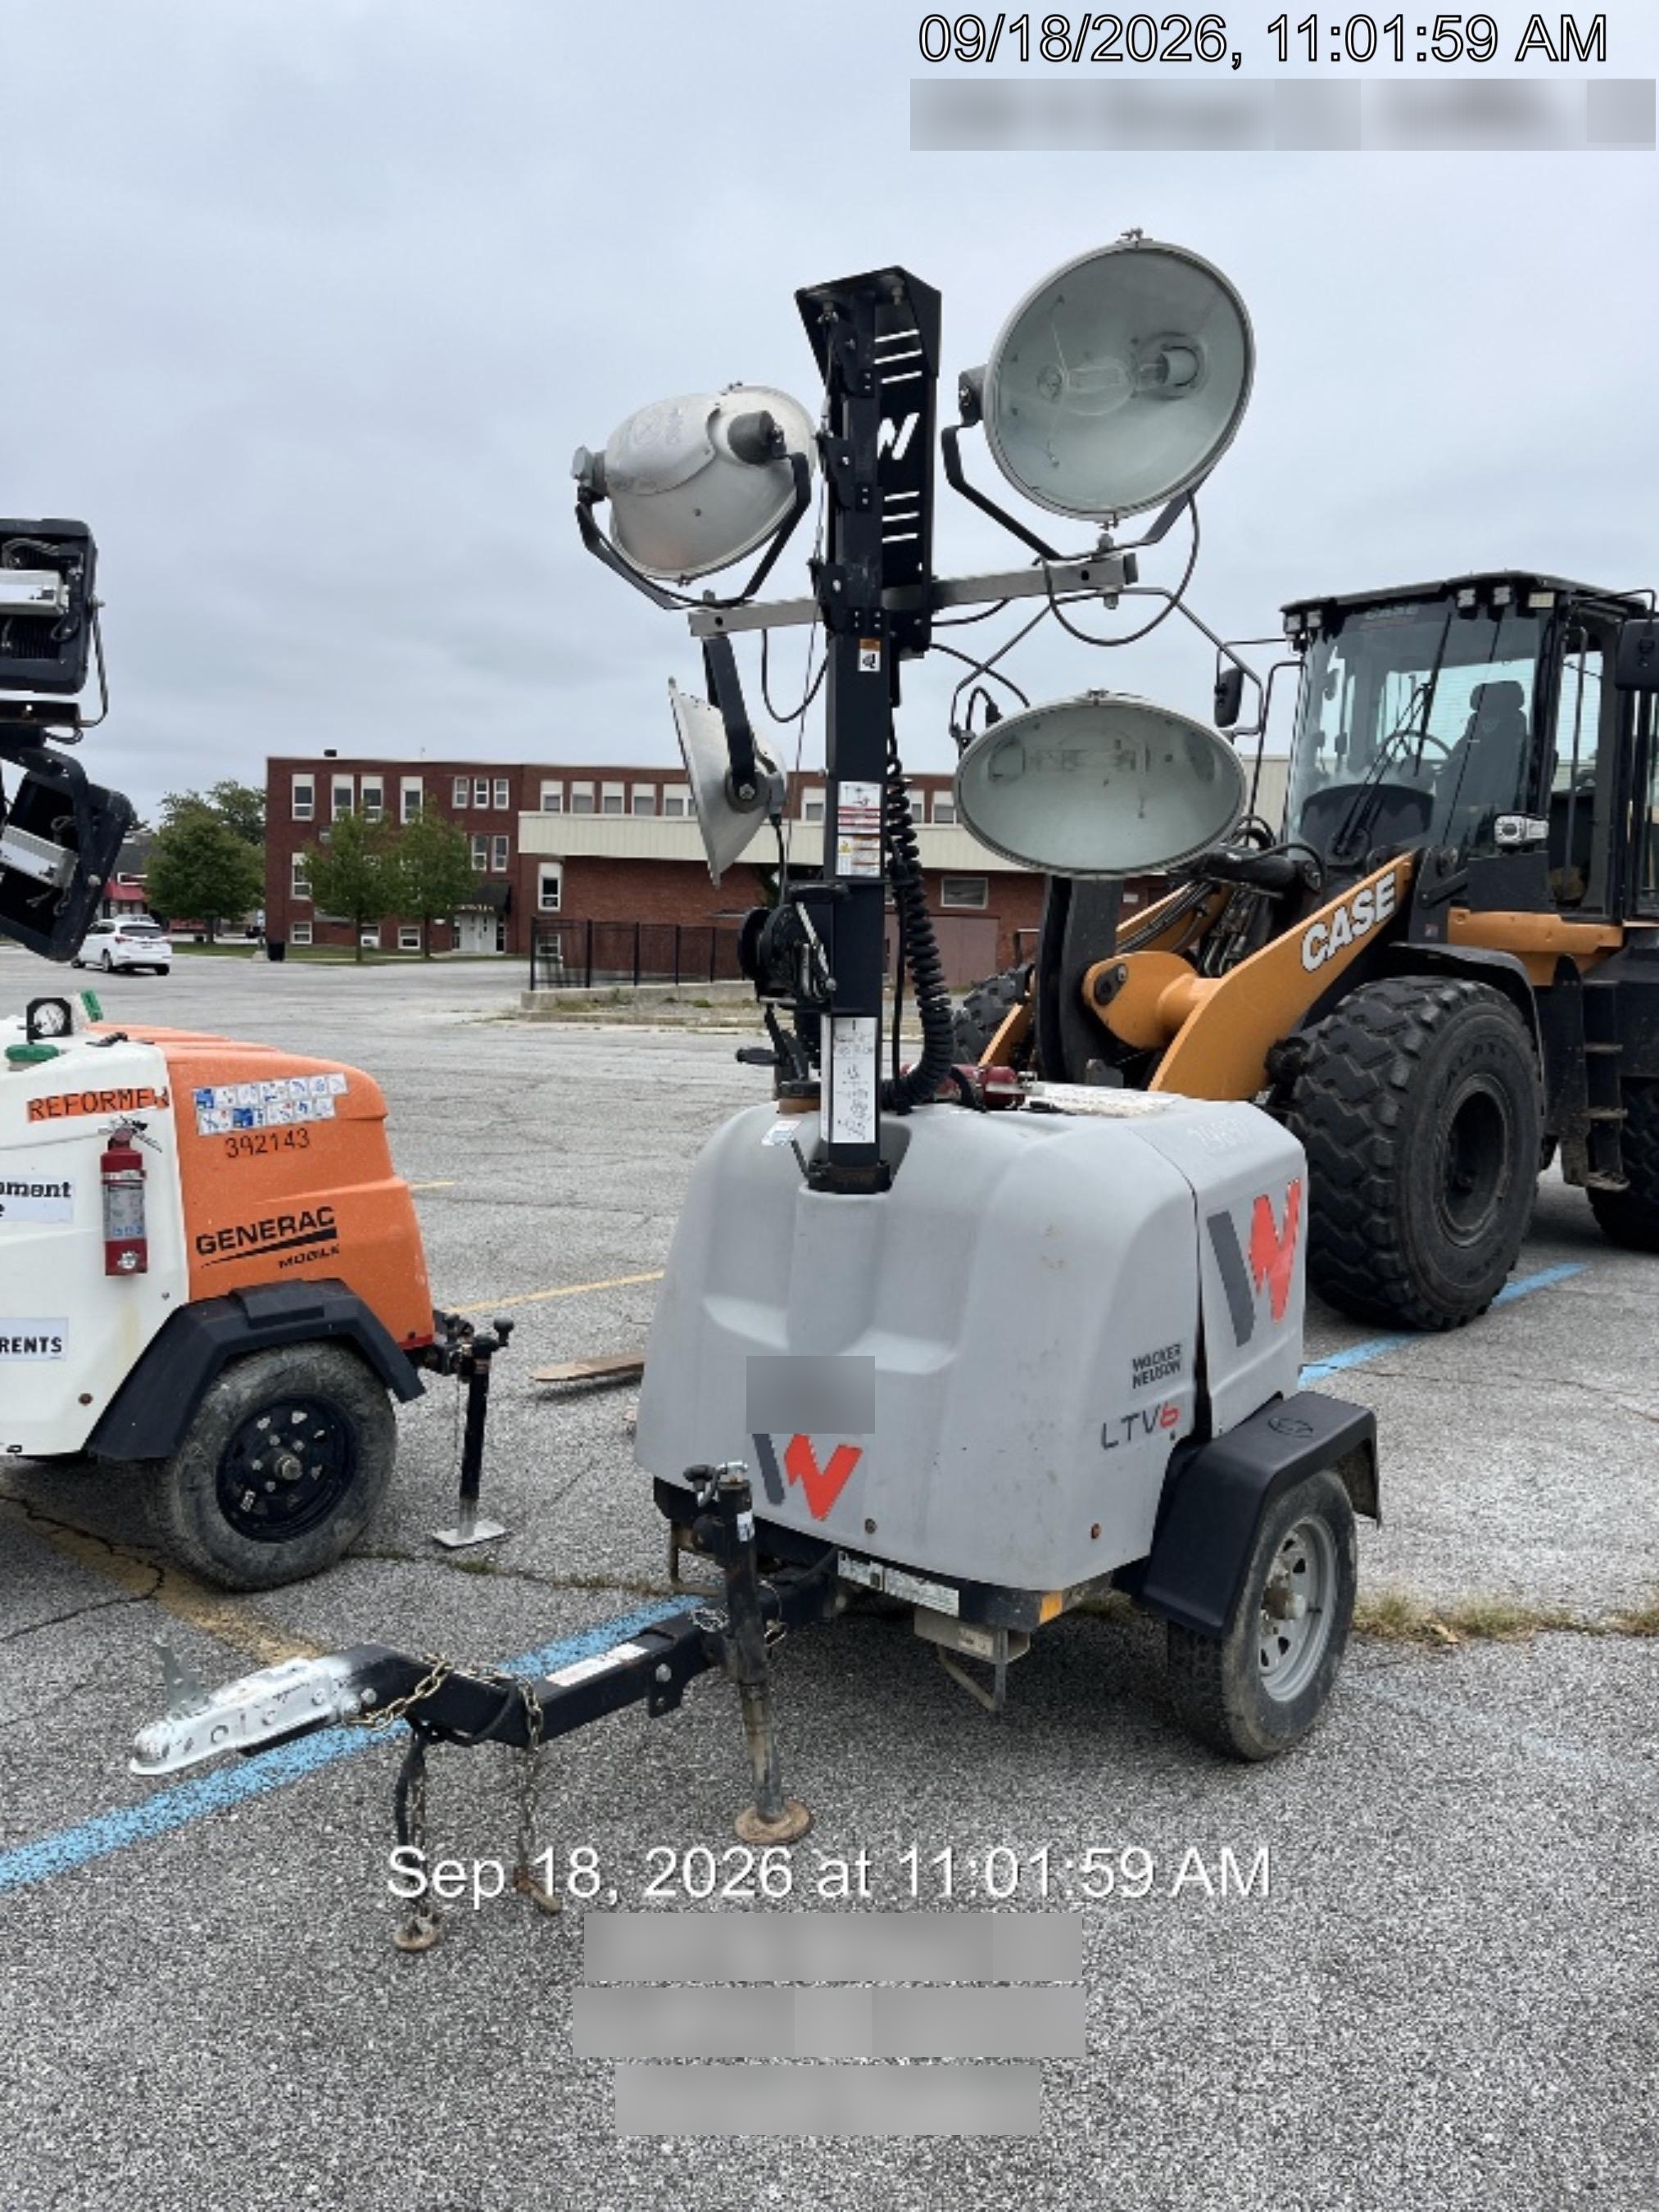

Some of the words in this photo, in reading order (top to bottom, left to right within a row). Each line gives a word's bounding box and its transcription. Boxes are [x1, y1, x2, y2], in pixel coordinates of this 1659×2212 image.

[1301, 871, 1395, 972] CASE
[225, 1127, 310, 1158] 392143
[195, 1206, 335, 1256] GENERAC
[1132, 1344, 1181, 1371] WACKER
[1132, 1360, 1181, 1389] NEUSON
[1101, 1403, 1181, 1449] LTV6
